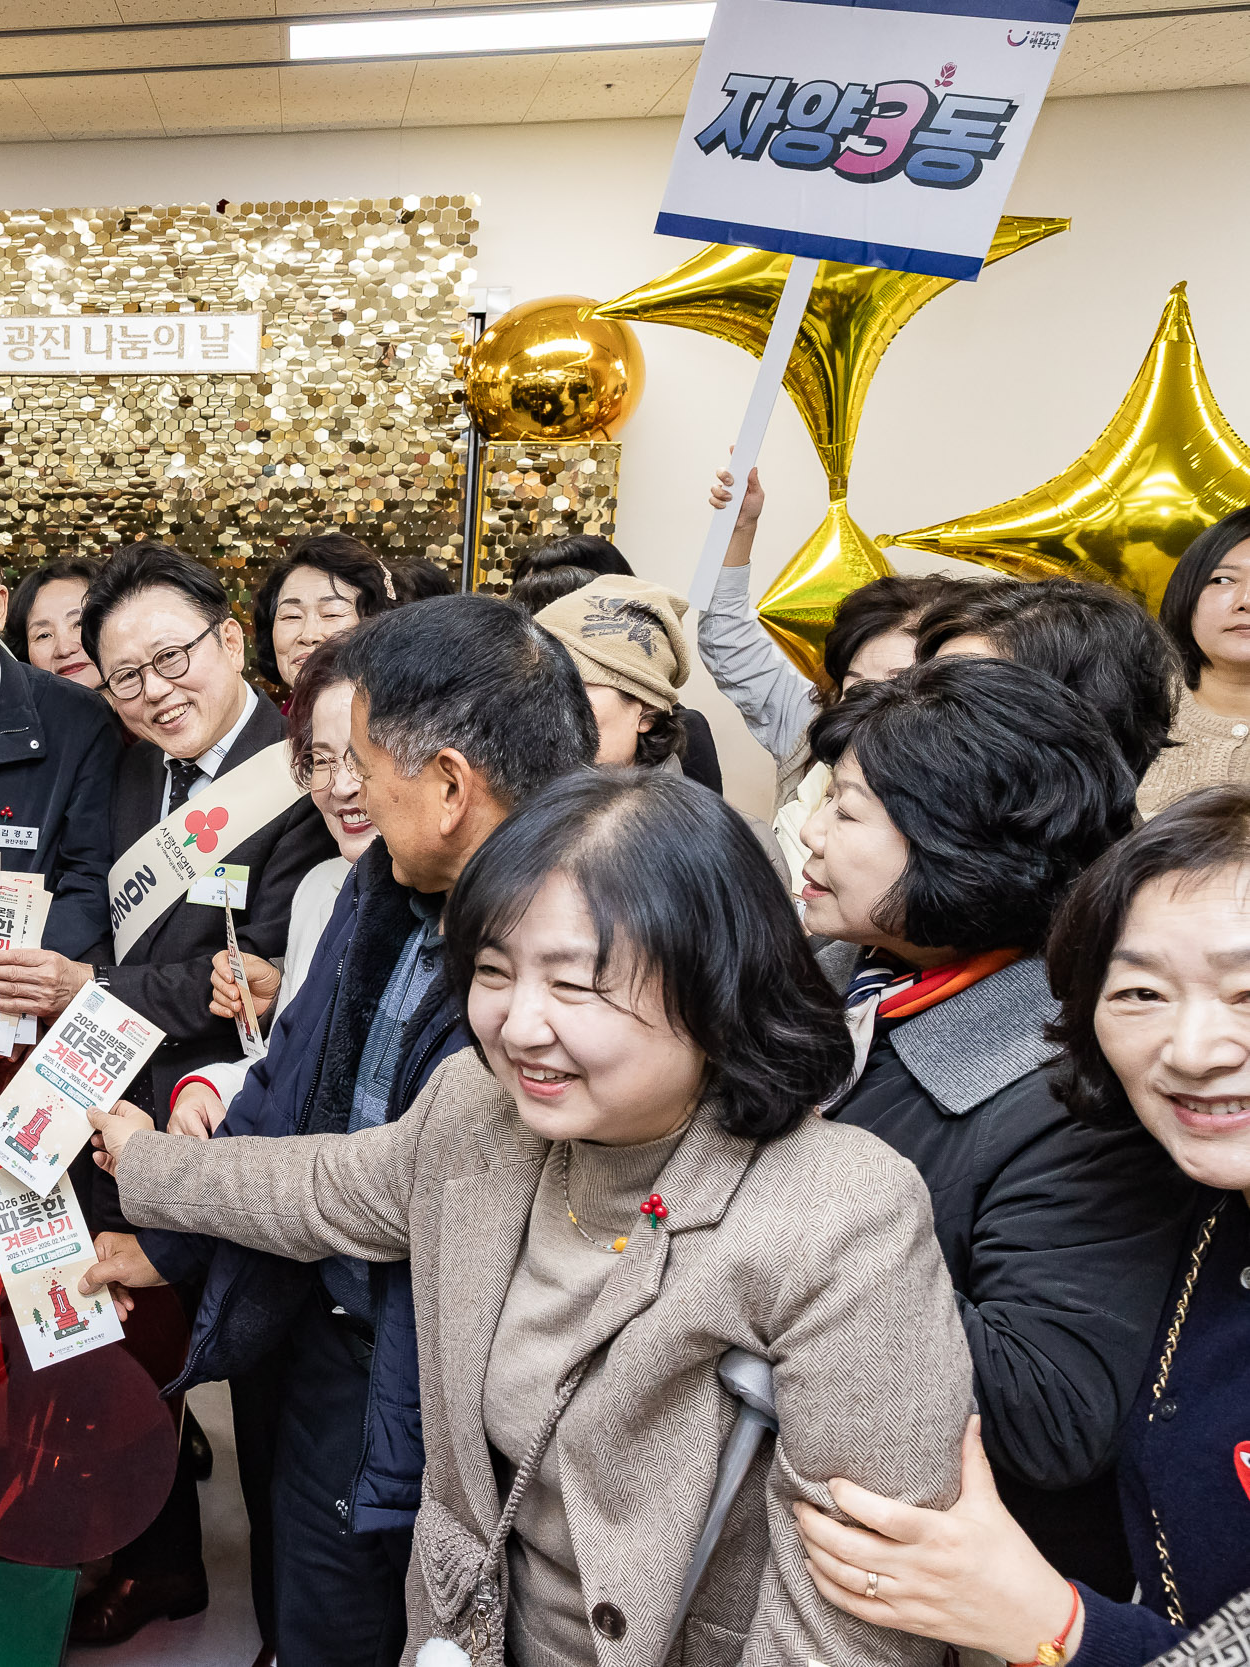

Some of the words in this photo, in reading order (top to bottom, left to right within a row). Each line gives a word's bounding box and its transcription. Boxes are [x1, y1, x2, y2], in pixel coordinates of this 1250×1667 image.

[694, 72, 1020, 190] 자양3동
[3, 324, 71, 362] 광진
[83, 323, 185, 361] 나눔의
[199, 322, 234, 360] 날
[59, 1022, 127, 1080] 따뜻한
[74, 1012, 97, 1033] 2026
[99, 1028, 137, 1061] 희망온돌
[49, 1040, 114, 1094] 겨울나기
[2, 1216, 73, 1251] 겨울나기
